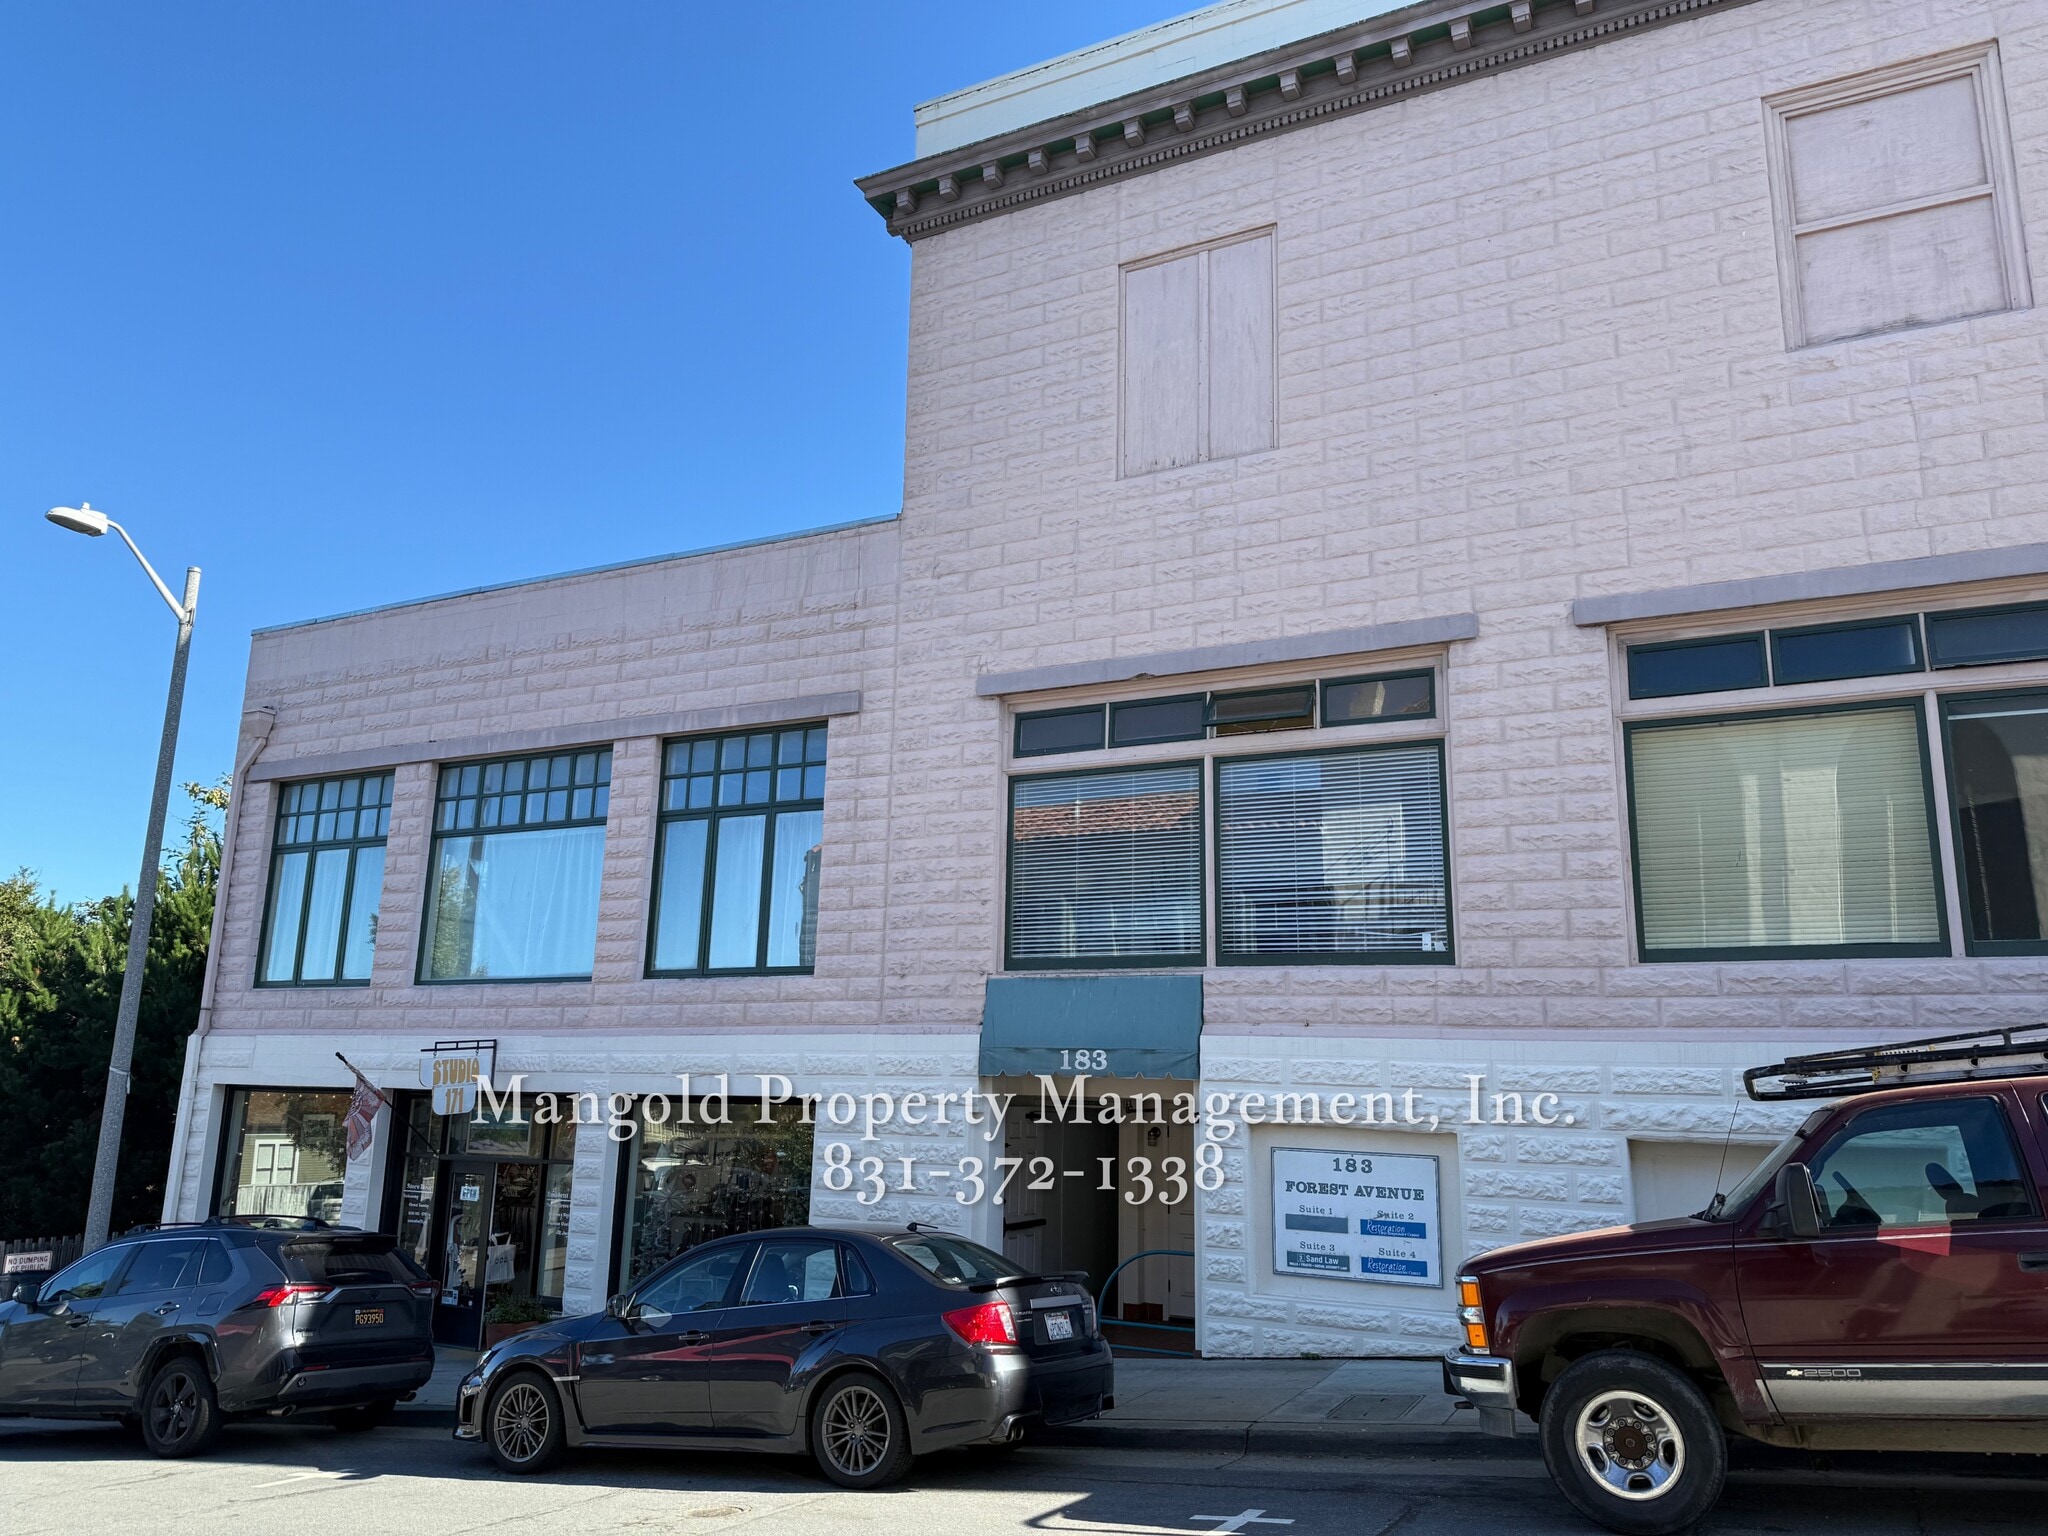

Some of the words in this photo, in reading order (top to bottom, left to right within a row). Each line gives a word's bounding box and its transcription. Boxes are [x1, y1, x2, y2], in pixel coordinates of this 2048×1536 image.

[1060, 1049, 1108, 1070] 183
[433, 1057, 479, 1085] STUDIO
[445, 1088, 464, 1114] 171
[1332, 1157, 1373, 1173] 183
[1285, 1180, 1349, 1196] FOREST
[1353, 1185, 1425, 1201] AVENUE
[1299, 1205, 1325, 1214] Suite
[1328, 1207, 1333, 1215] 1
[1376, 1210, 1404, 1220] Suite
[1408, 1212, 1414, 1220] 2
[1367, 1220, 1406, 1234] Restoration
[1300, 1241, 1326, 1250] Suite
[1379, 1248, 1406, 1257] Suite
[20, 1256, 48, 1264] DUMPING
[1306, 1255, 1323, 1263] Sand
[1324, 1256, 1339, 1265] Law
[1368, 1258, 1407, 1272] Restoration
[355, 1313, 384, 1325] PG93950
[1804, 1369, 1861, 1377] 2500
